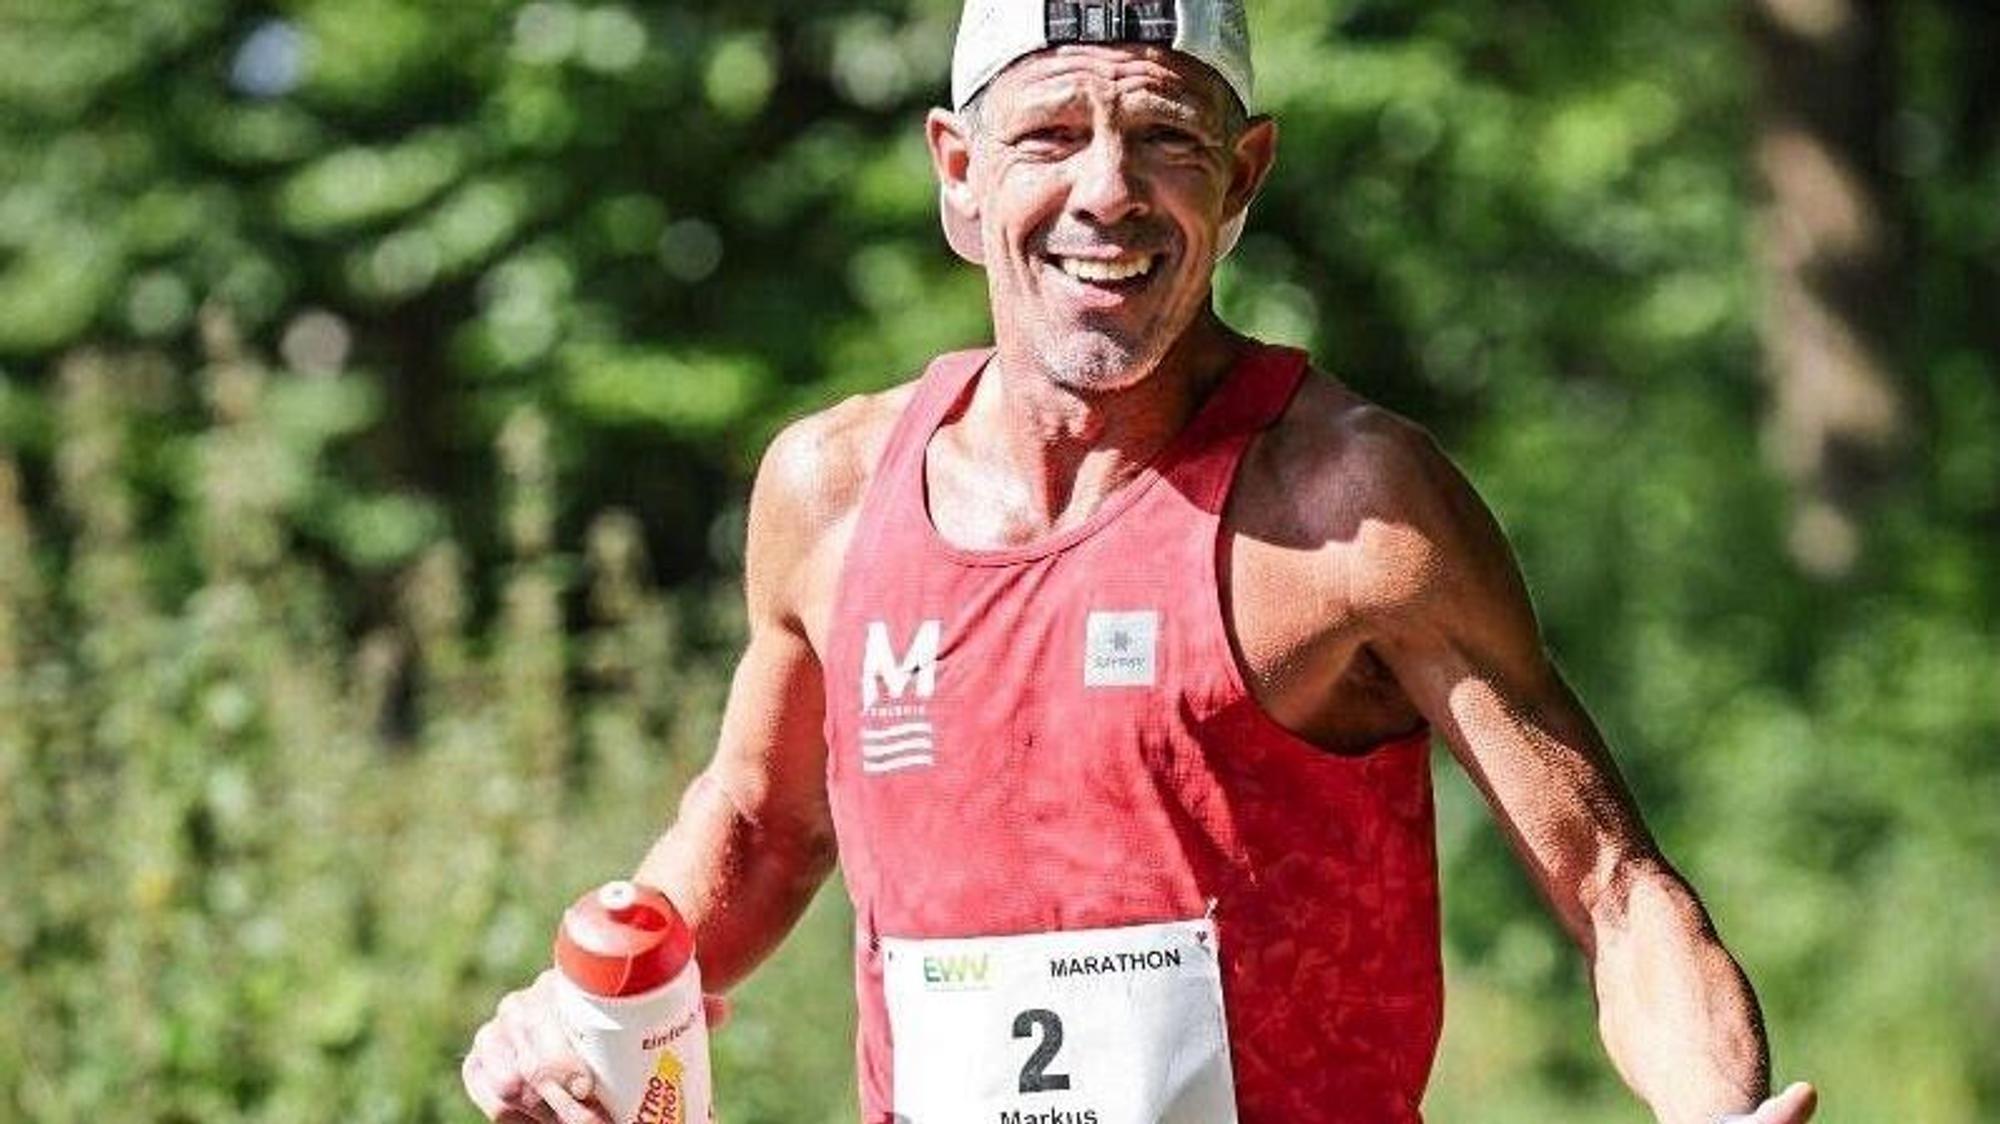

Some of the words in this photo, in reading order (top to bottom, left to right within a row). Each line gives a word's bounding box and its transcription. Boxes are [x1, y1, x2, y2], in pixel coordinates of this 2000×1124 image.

[1050, 949, 1181, 977] MARATHON
[1012, 1008, 1070, 1094] 2
[1001, 1106, 1098, 1124] Markus
